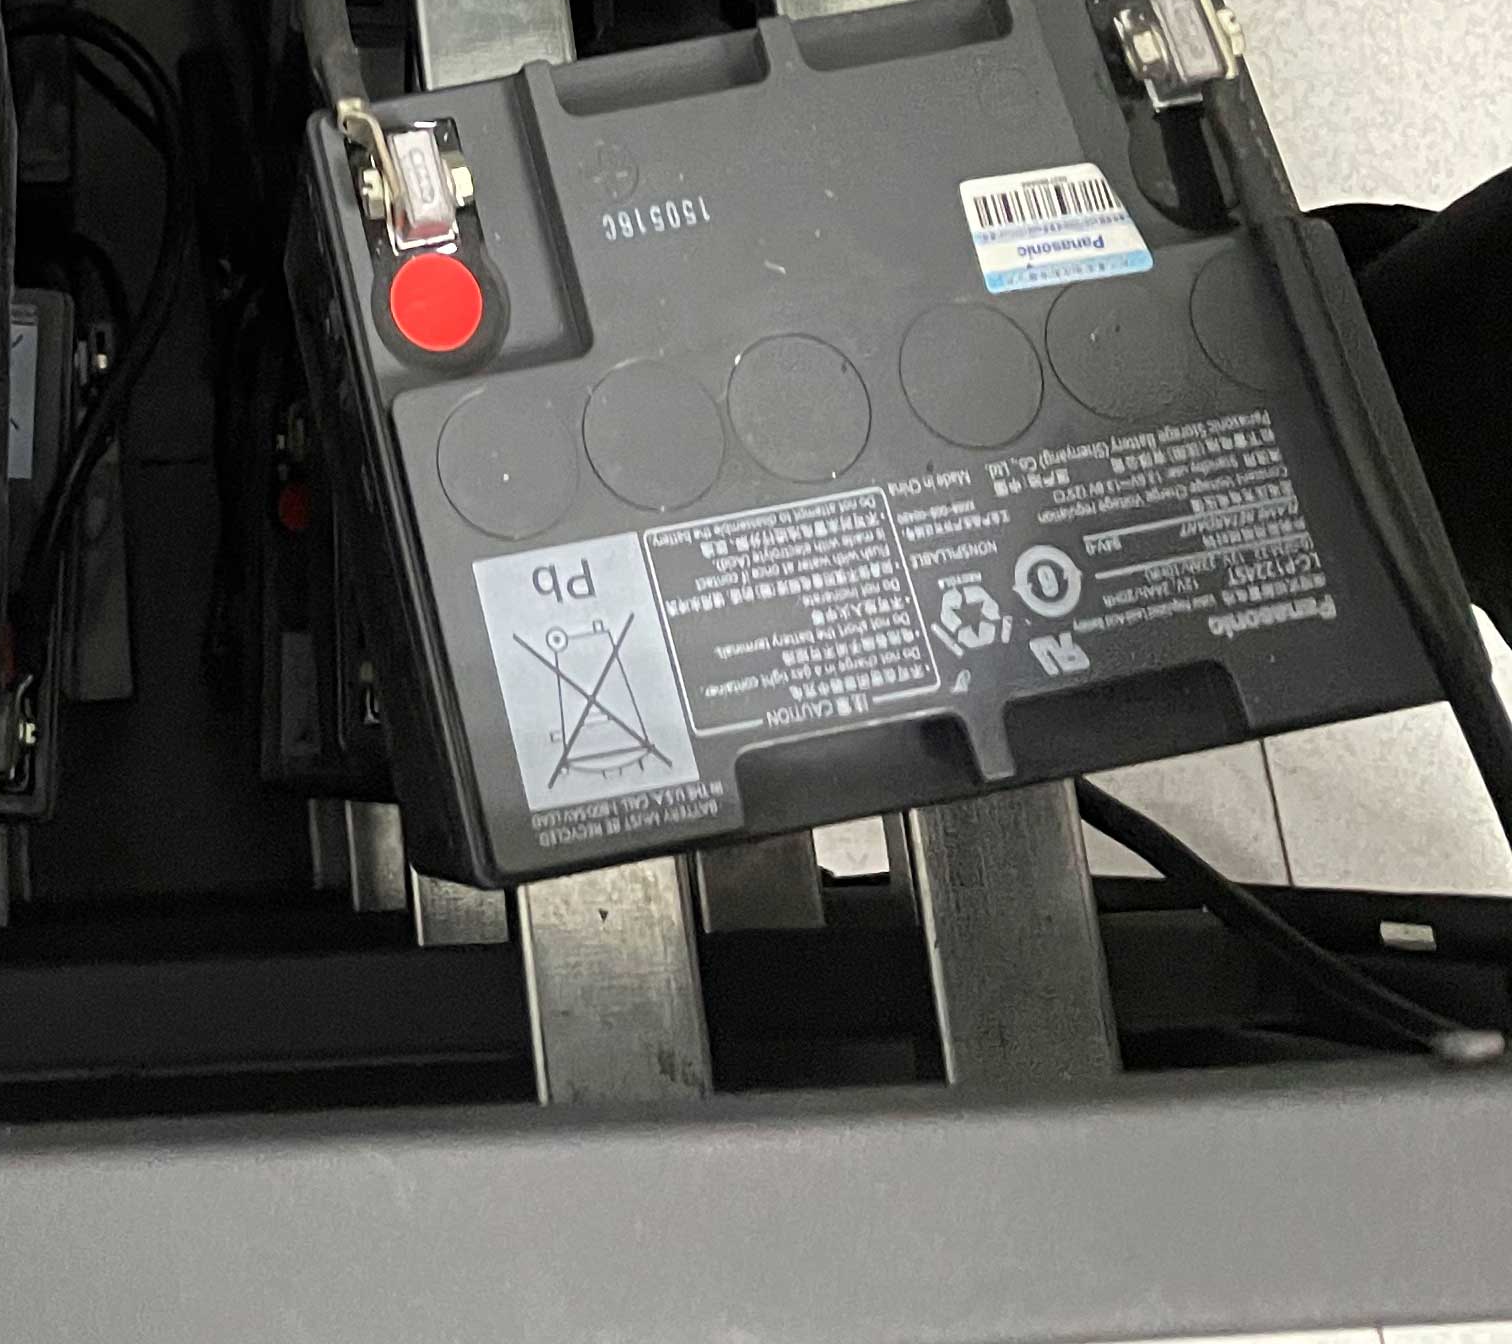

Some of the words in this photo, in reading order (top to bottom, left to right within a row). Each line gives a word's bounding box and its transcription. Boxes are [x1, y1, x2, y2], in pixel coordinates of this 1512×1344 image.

[600, 194, 711, 242] 150516C
[1016, 231, 1104, 262] Panasonic
[529, 554, 595, 607] Pb
[765, 699, 834, 727] CAUTION
